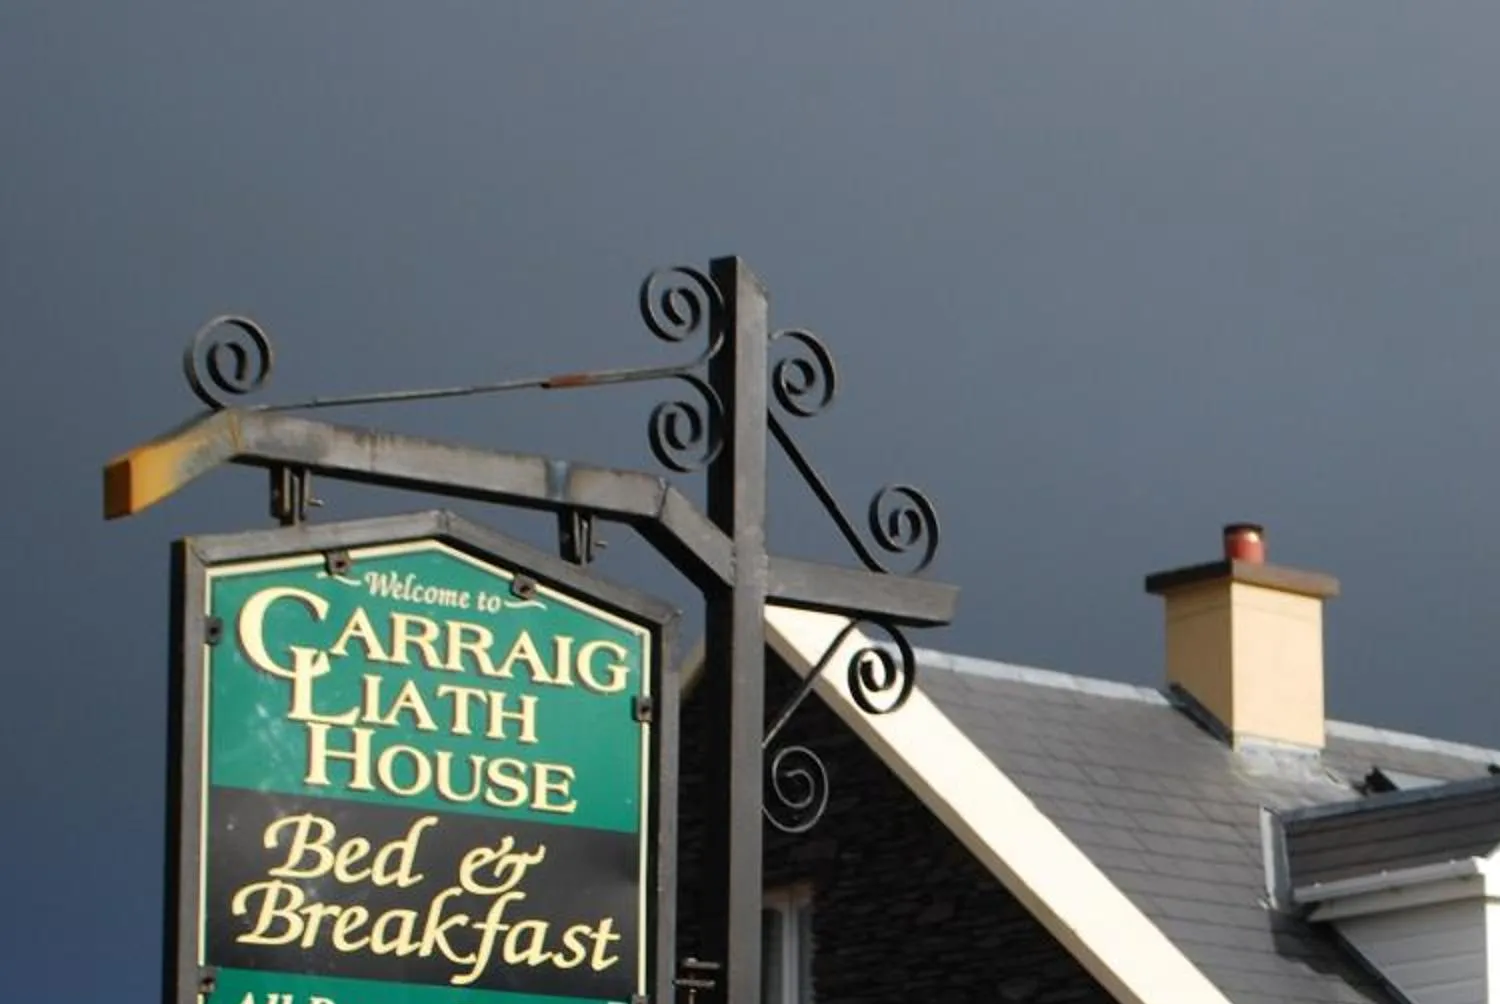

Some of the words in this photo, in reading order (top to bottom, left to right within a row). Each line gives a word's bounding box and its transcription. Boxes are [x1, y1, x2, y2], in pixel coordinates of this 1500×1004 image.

[237, 586, 630, 694] CARRAIG
[364, 570, 470, 610] Welcome
[477, 589, 501, 614] to
[288, 645, 539, 744] LIATH
[303, 720, 578, 814] HOUSE
[263, 813, 439, 887] Bed
[458, 835, 546, 895] &
[231, 880, 621, 986] Breakfast
